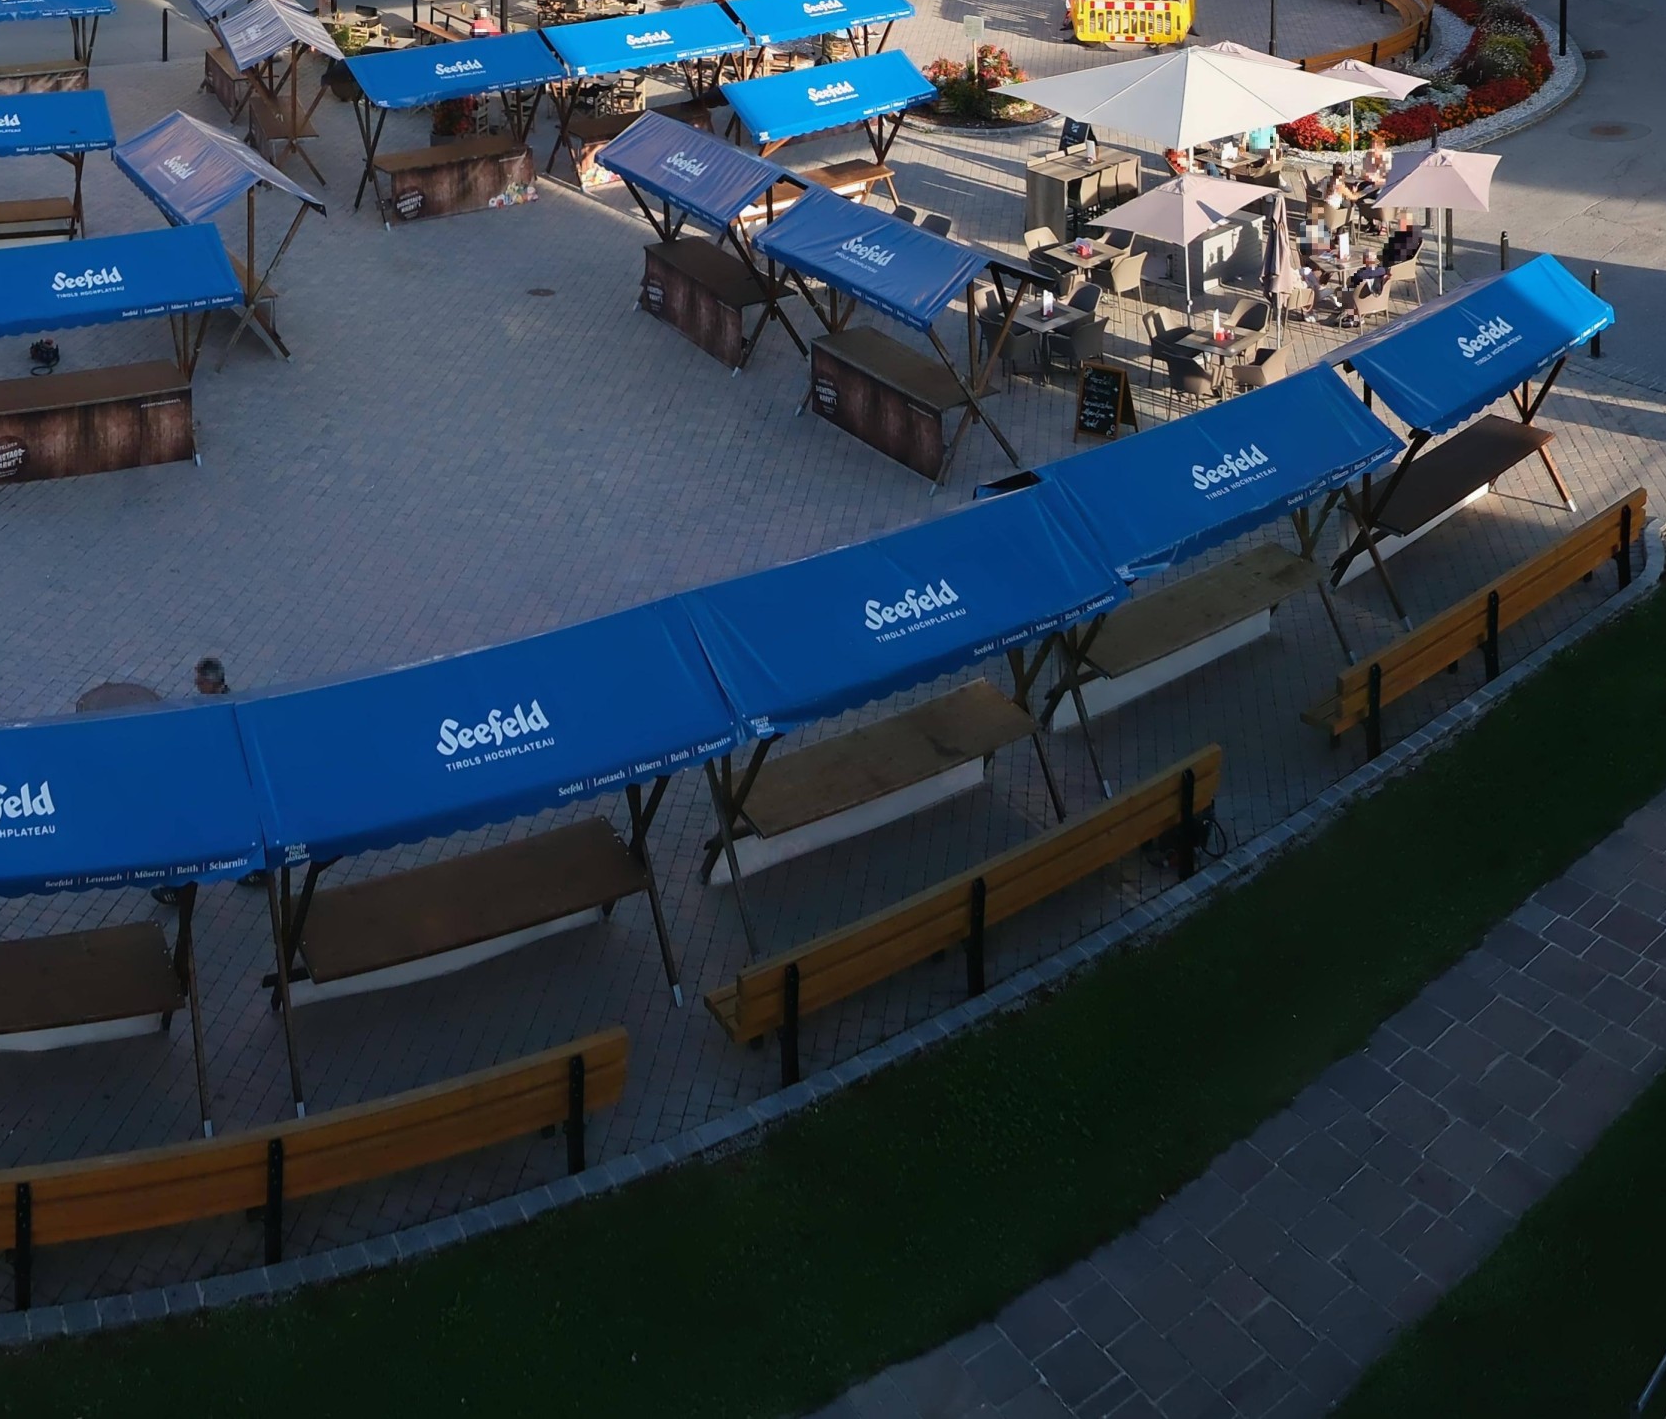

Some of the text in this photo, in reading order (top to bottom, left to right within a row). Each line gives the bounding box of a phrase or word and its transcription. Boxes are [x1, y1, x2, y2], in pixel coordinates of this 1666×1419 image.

[626, 30, 671, 46] Seefeld
[435, 59, 483, 75] Seefeld
[808, 81, 855, 101] Seefeld
[841, 236, 896, 267] Seefeld
[52, 266, 122, 291] Seefeld
[1458, 316, 1514, 359] Seefeld
[1192, 444, 1269, 490] Seefeld
[1205, 466, 1277, 501] TIROLS HOCHPLATEAU
[865, 579, 959, 631] Seefeld
[876, 608, 967, 643] TIROLS HOCHPLATEAU
[436, 699, 550, 756] Seefeld
[445, 736, 555, 772] TIROLS HOCHPLATEAU
[557, 736, 732, 797] Seefeld Leutasch Mösern Reith Scharnitz
[45, 857, 249, 888] Seefeld Leutasch Mösern Reith Scharnitz
